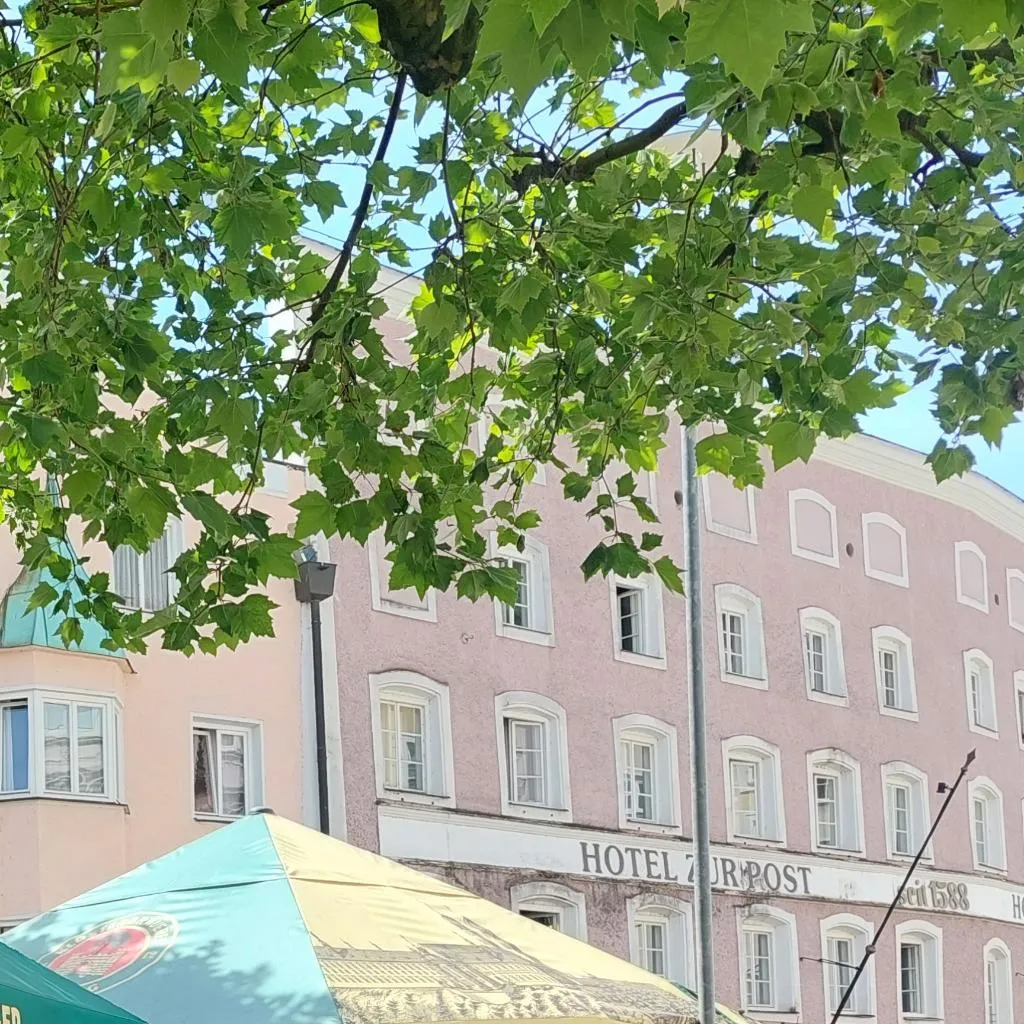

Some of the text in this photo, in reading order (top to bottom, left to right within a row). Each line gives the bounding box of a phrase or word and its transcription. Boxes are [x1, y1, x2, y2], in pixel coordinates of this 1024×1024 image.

[580, 841, 678, 881] HOTEL
[746, 860, 811, 894] POST
[928, 880, 970, 911] 1588
